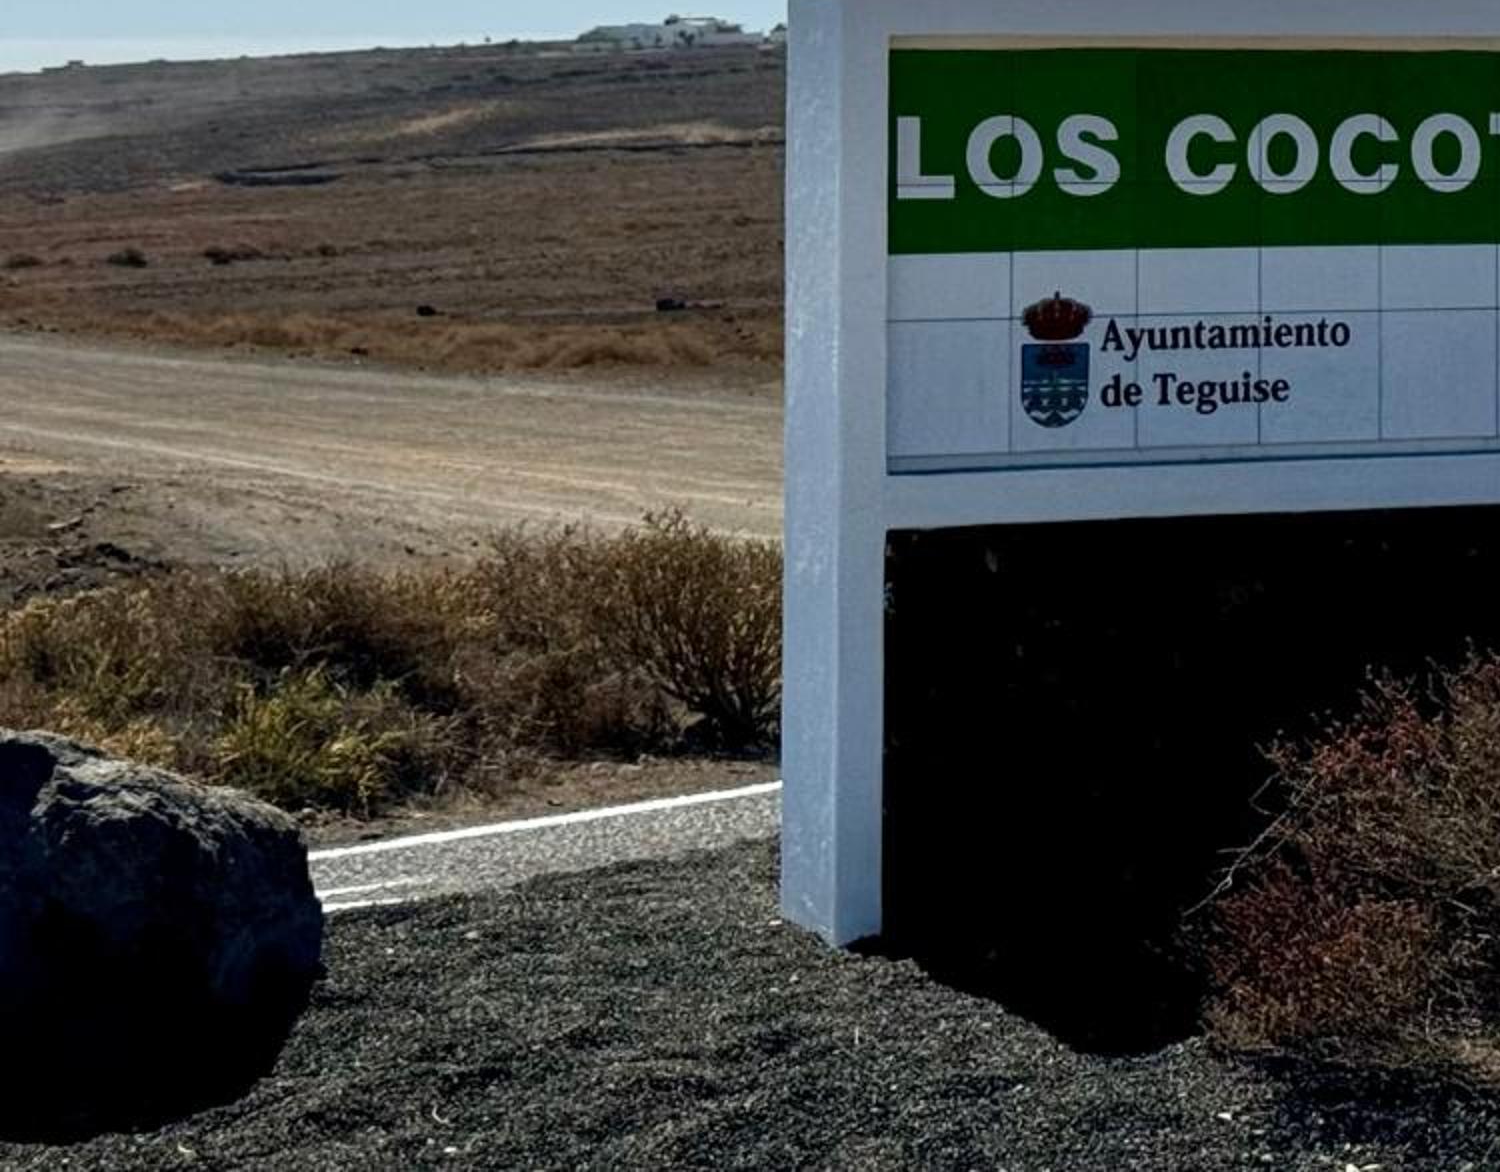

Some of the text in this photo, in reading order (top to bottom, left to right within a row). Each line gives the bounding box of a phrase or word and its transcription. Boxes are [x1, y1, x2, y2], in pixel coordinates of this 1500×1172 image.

[896, 113, 1121, 200] LOS
[1100, 316, 1351, 361] Ayuntamiento
[1100, 371, 1290, 414] de Teguise
